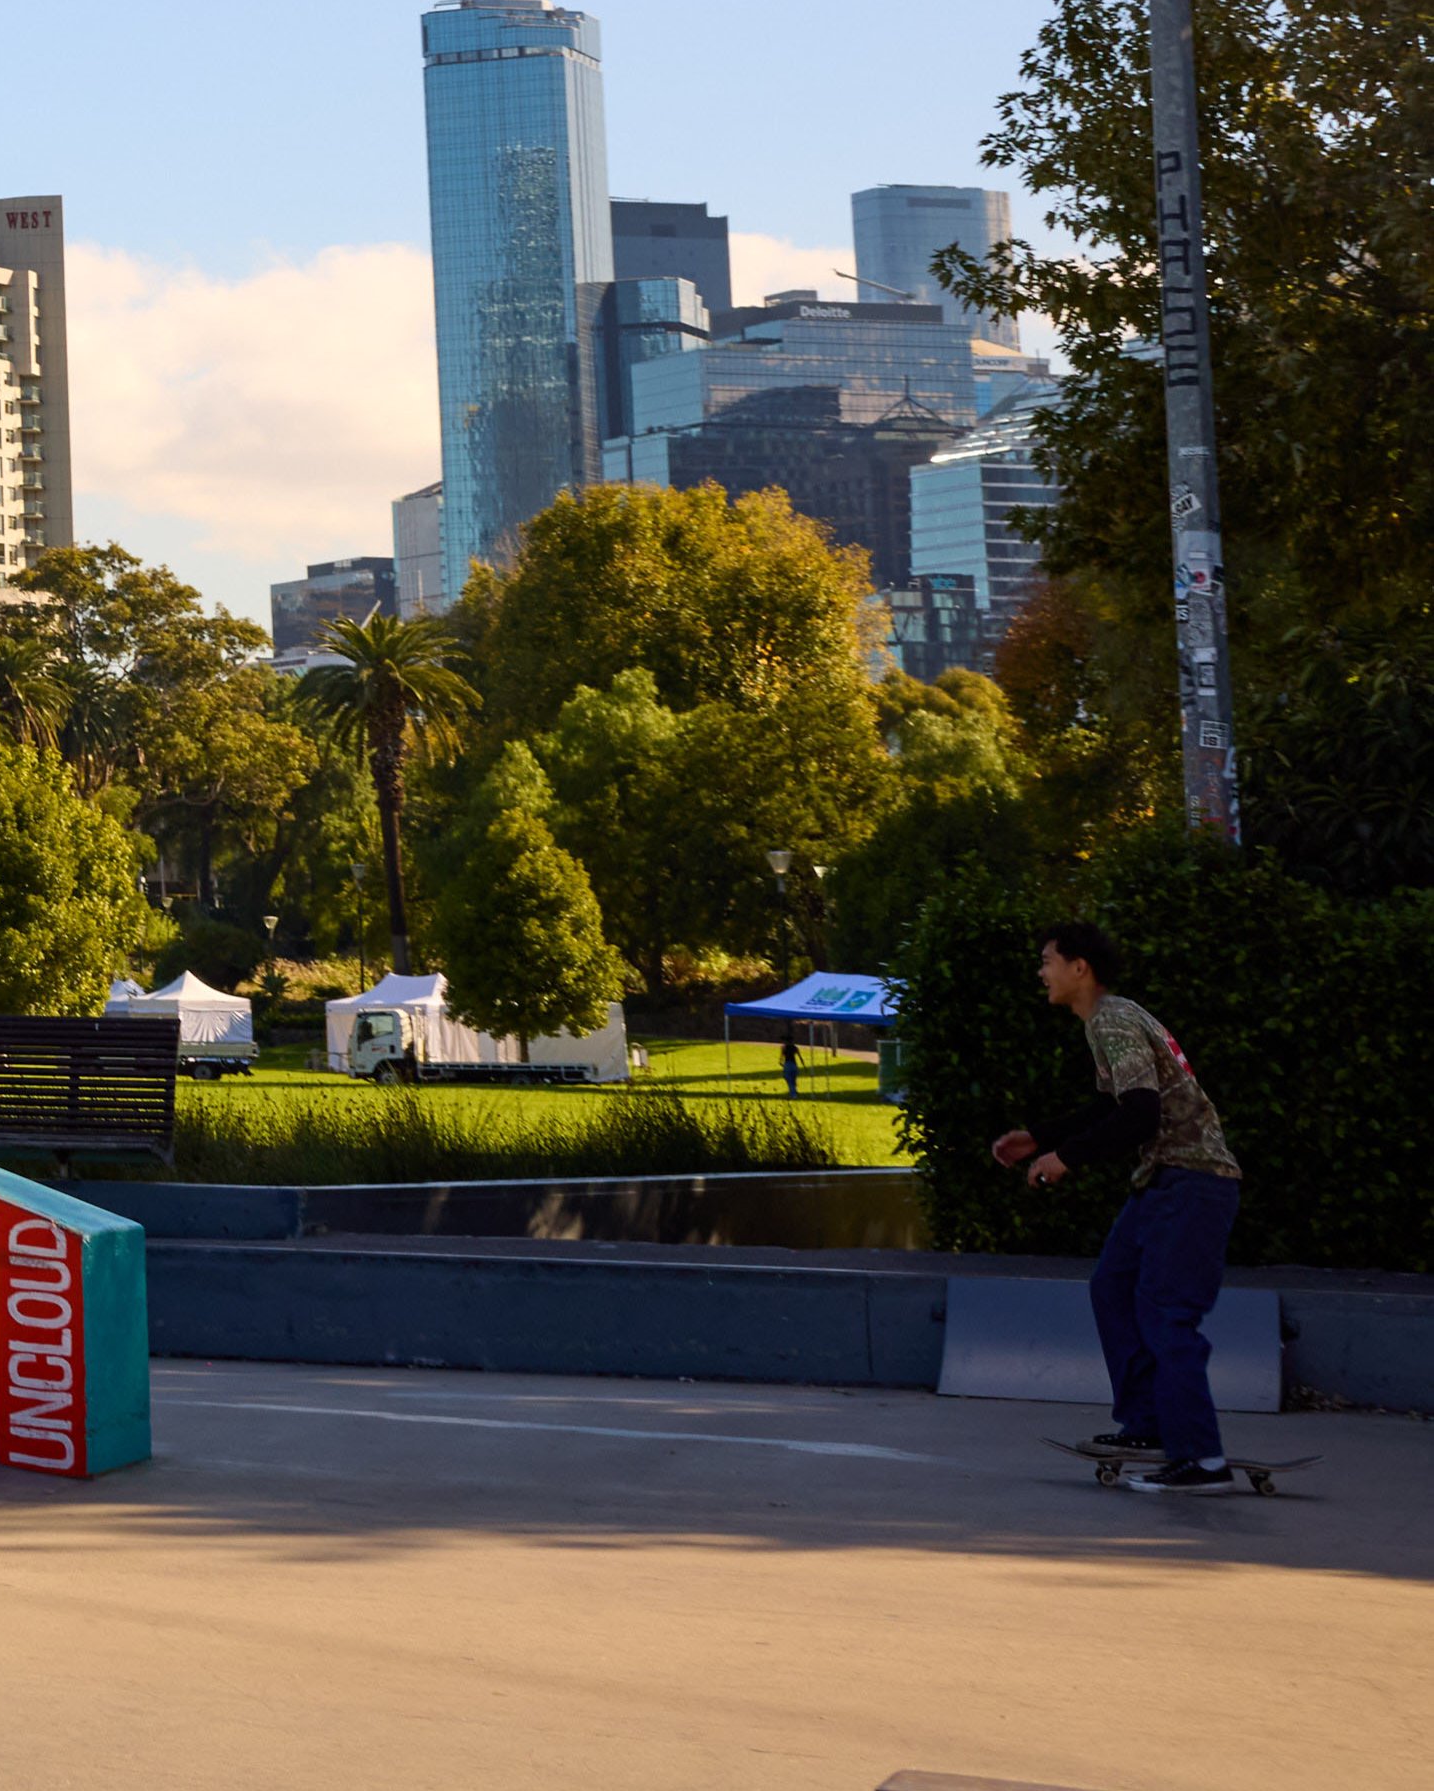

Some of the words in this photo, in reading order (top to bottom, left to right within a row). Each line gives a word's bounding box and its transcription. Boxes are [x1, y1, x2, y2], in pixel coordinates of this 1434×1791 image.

[6, 210, 52, 230] WEST
[800, 305, 850, 319] Deloitte
[7, 1218, 75, 1470] UNCLOUD
